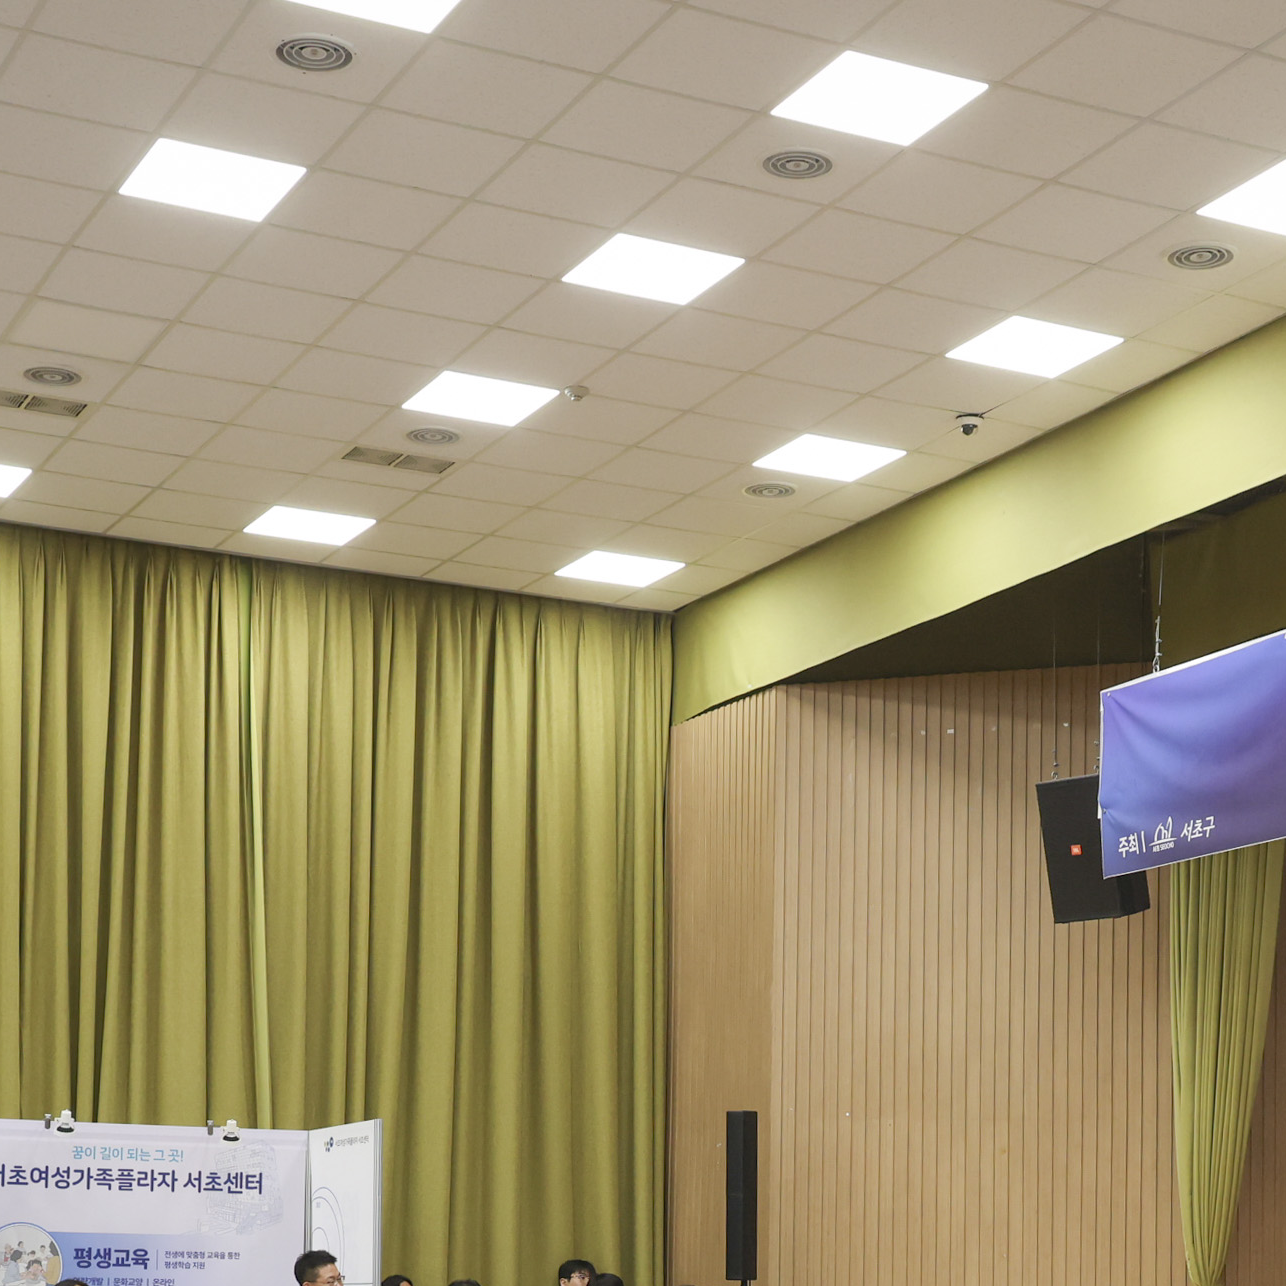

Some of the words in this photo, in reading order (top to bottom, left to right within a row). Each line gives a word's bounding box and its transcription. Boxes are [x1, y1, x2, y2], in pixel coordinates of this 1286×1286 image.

[1118, 832, 1139, 858] 주최
[1180, 815, 1215, 842] 서초구
[72, 1145, 97, 1160] 꿈이
[100, 1146, 123, 1161] 길이
[127, 1147, 151, 1162] 되는
[153, 1148, 165, 1161] 그
[168, 1148, 184, 1163] 곳!
[183, 1171, 264, 1195] 서초센터
[73, 1247, 150, 1270] 평생교육
[186, 1250, 205, 1260] 맞춤형
[207, 1251, 225, 1260] 교육을
[227, 1251, 240, 1260] 통한
[164, 1260, 191, 1270] 평생학습
[193, 1261, 206, 1270] 지원
[114, 1278, 143, 1286] 문화교양
[152, 1278, 175, 1286] 온라인
